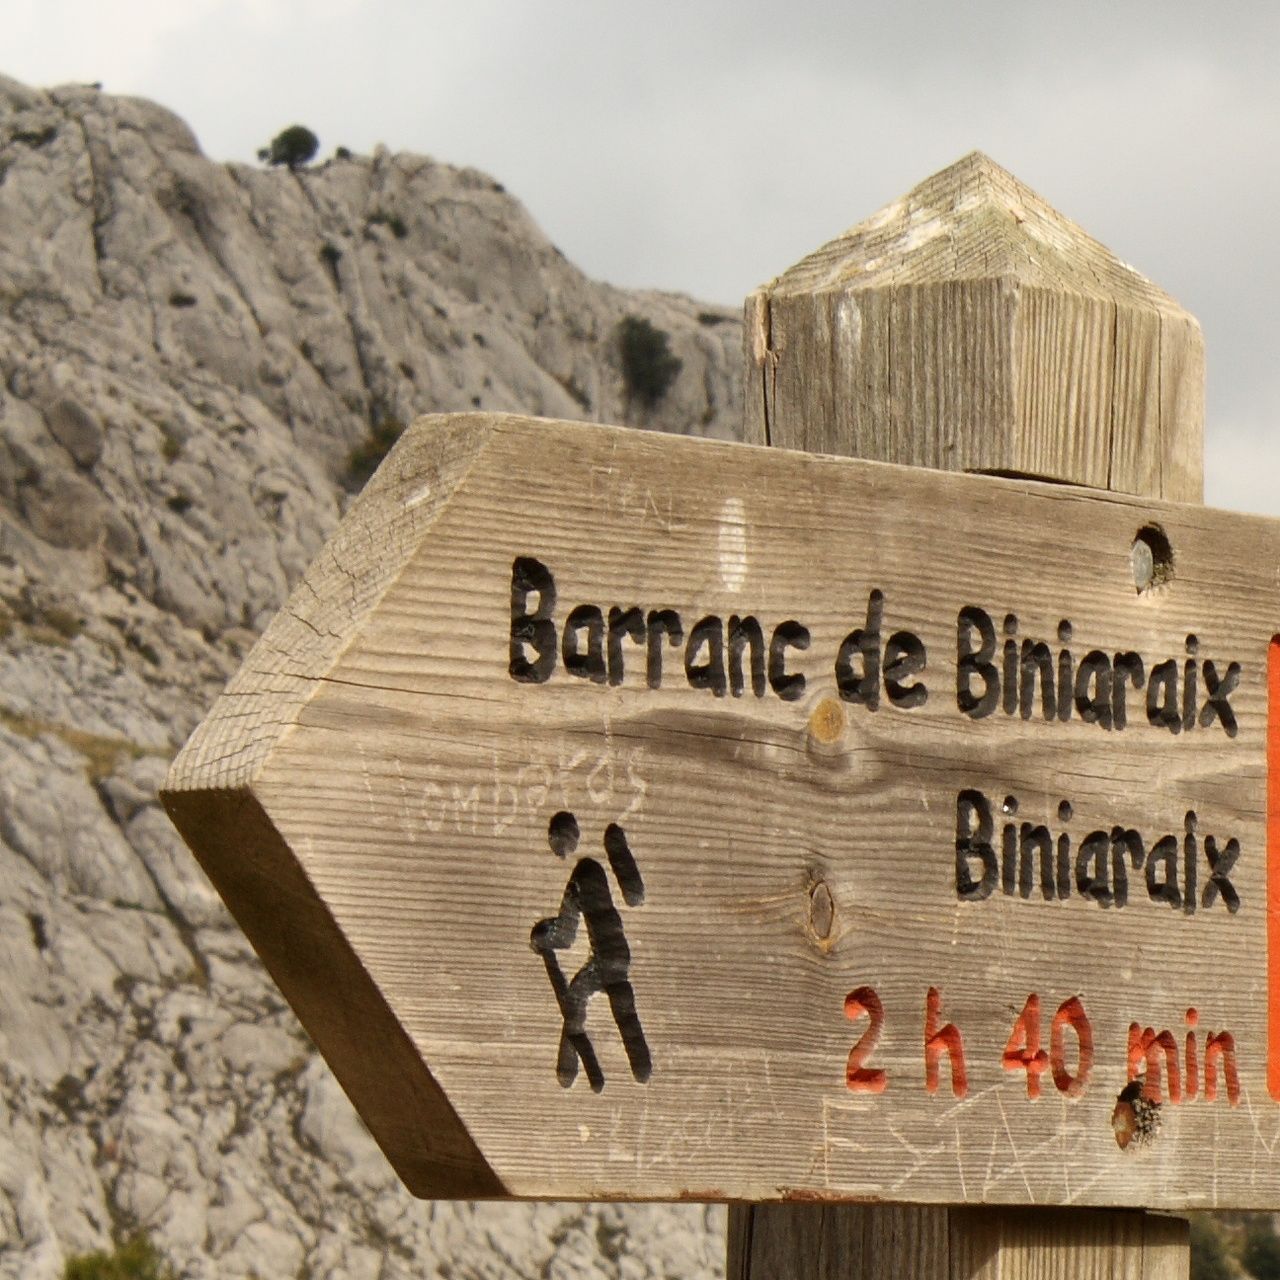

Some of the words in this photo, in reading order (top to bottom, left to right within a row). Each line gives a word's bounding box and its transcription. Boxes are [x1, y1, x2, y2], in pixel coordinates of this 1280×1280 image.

[509, 556, 811, 701] Barranc
[835, 588, 929, 712] de
[956, 606, 1241, 738] Biniaraix
[956, 789, 1241, 914] Biniaraix
[844, 986, 888, 1095] 2
[924, 986, 968, 1099] h
[1002, 993, 1094, 1100] 40
[1126, 1007, 1241, 1108] min
